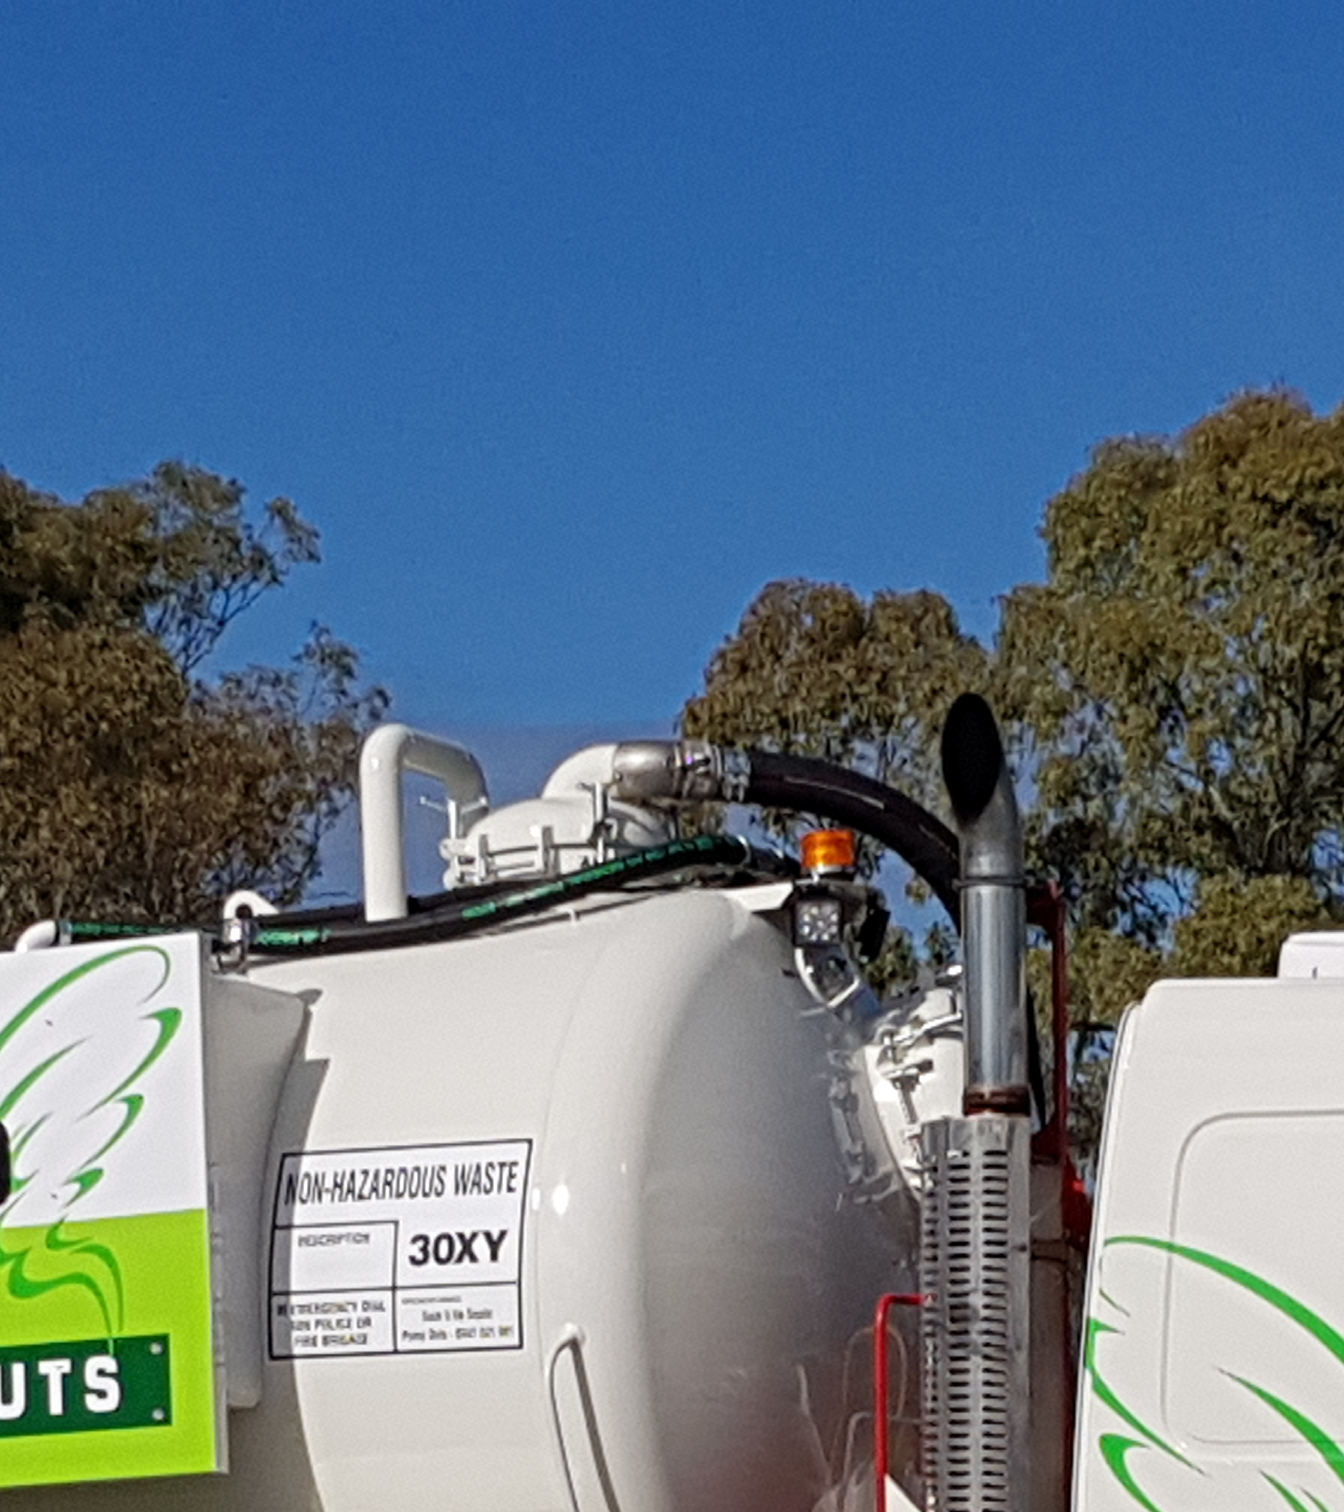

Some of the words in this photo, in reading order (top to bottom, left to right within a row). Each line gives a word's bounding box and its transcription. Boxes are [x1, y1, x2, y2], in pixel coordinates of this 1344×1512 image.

[284, 1165, 447, 1206] NON-HAZARDOUS
[454, 1161, 520, 1196] WASTE
[408, 1229, 508, 1266] 30XY
